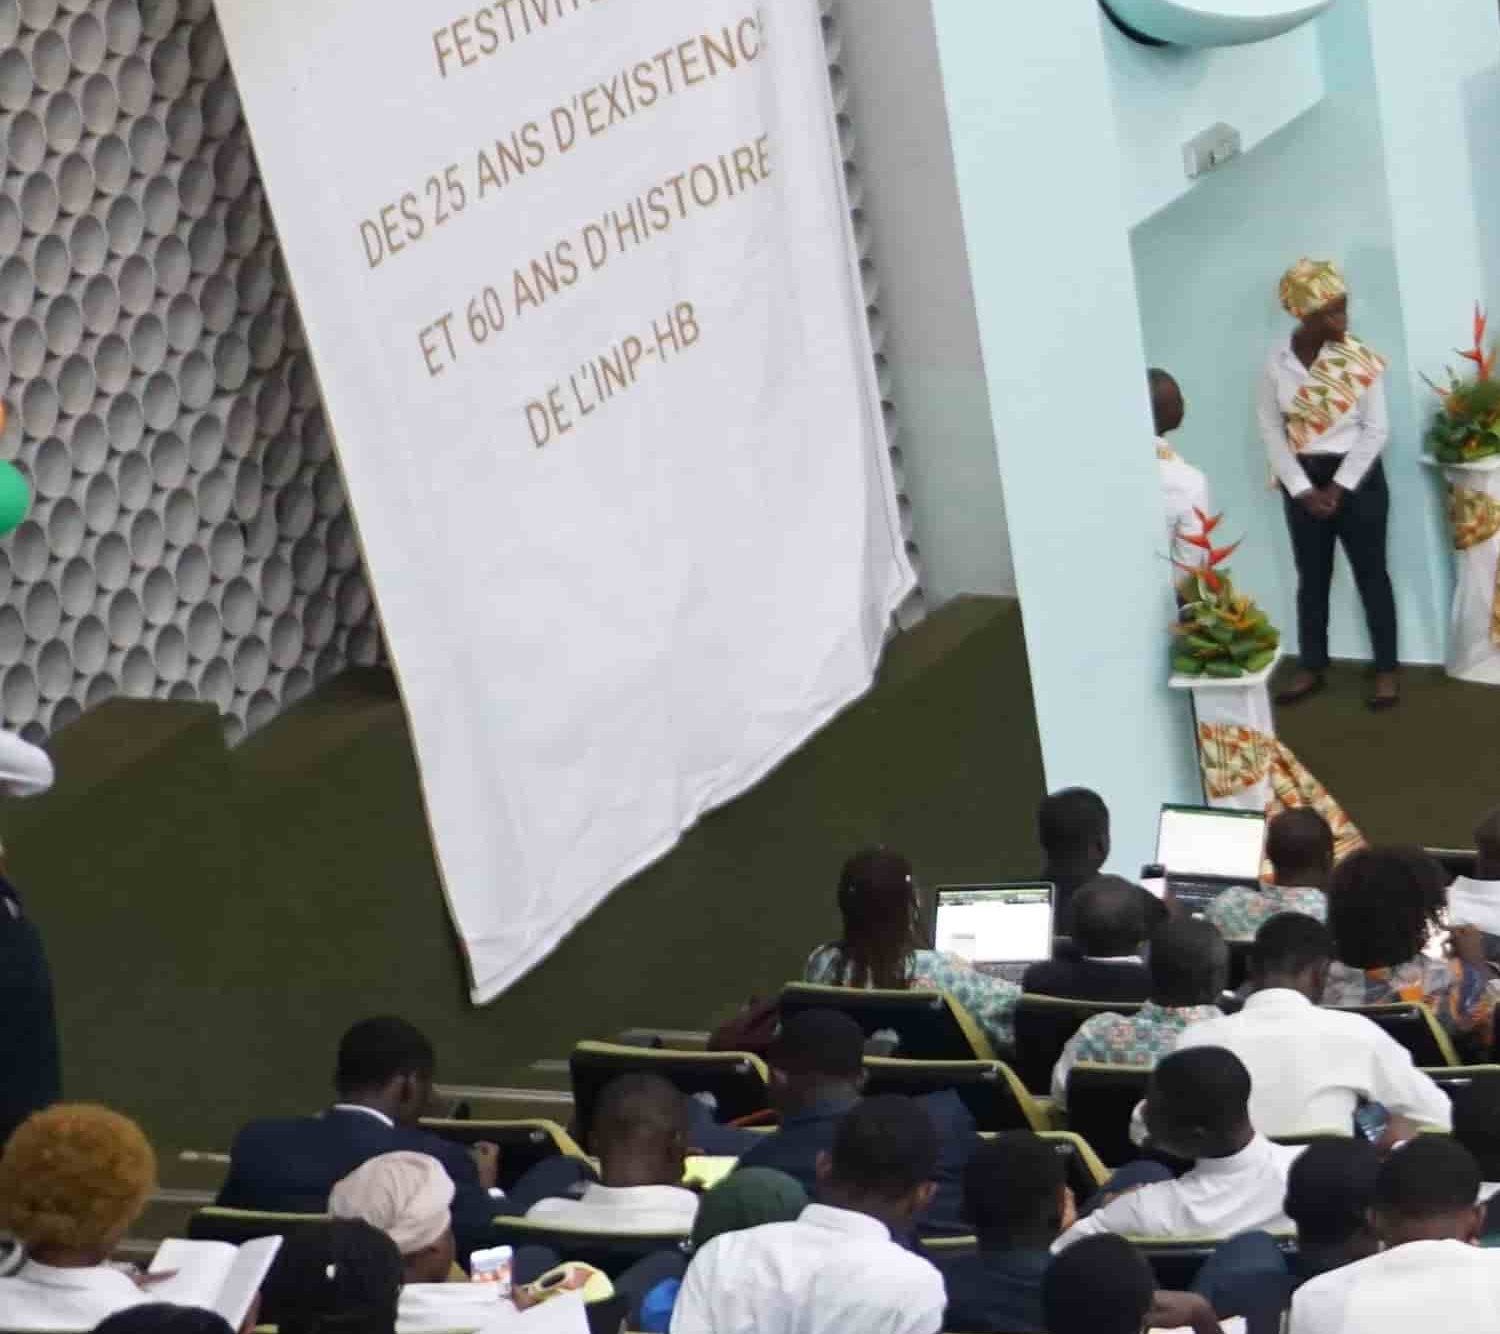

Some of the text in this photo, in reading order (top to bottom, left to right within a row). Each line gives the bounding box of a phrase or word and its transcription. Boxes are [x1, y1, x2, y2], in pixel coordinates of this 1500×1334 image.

[360, 193, 425, 269] DES
[426, 164, 466, 225] 25
[477, 121, 545, 198] ANS
[418, 134, 770, 377] ET 60 ANS D'HISTOIRE
[526, 300, 699, 449] DE L'INP-HB
